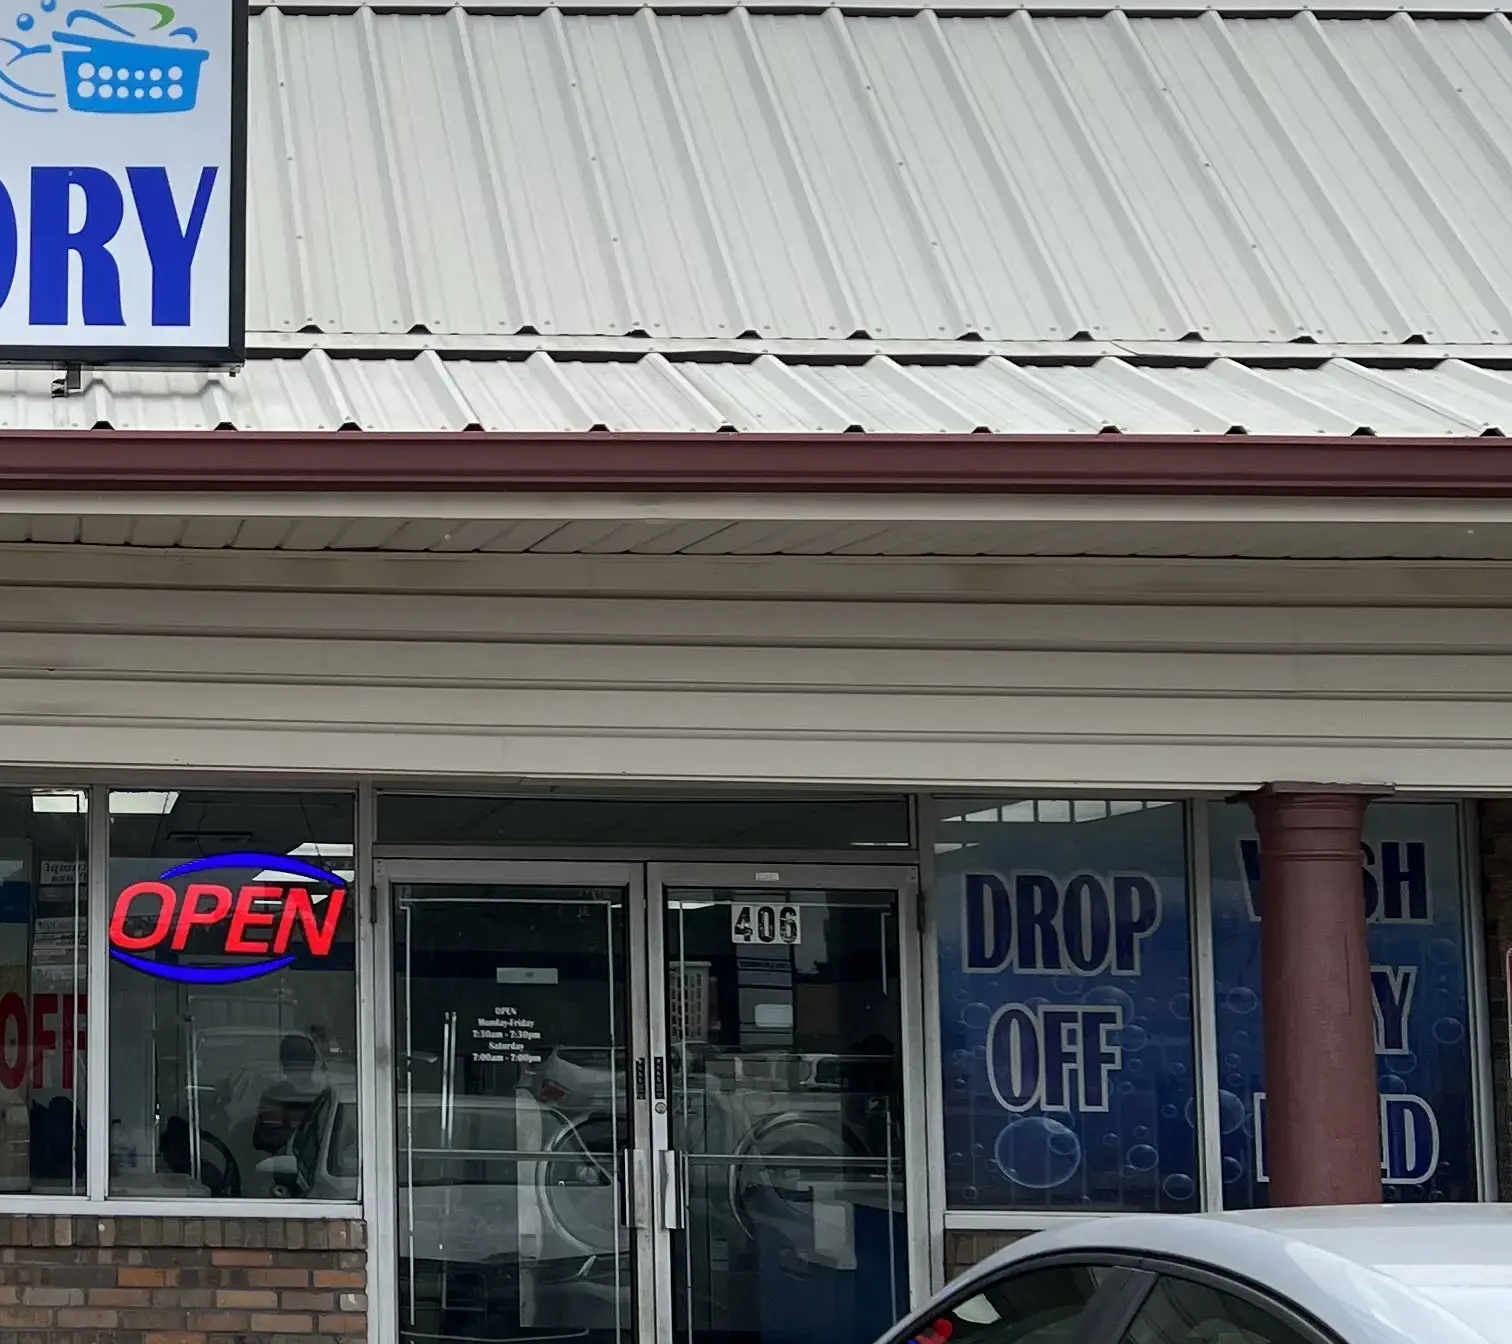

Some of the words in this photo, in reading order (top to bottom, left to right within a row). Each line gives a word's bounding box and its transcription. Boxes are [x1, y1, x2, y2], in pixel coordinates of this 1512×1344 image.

[108, 880, 346, 956] OPEN
[734, 905, 798, 943] 406
[962, 870, 1163, 976] DROP
[494, 1006, 517, 1016] OPEN
[987, 1002, 1124, 1113] OFF
